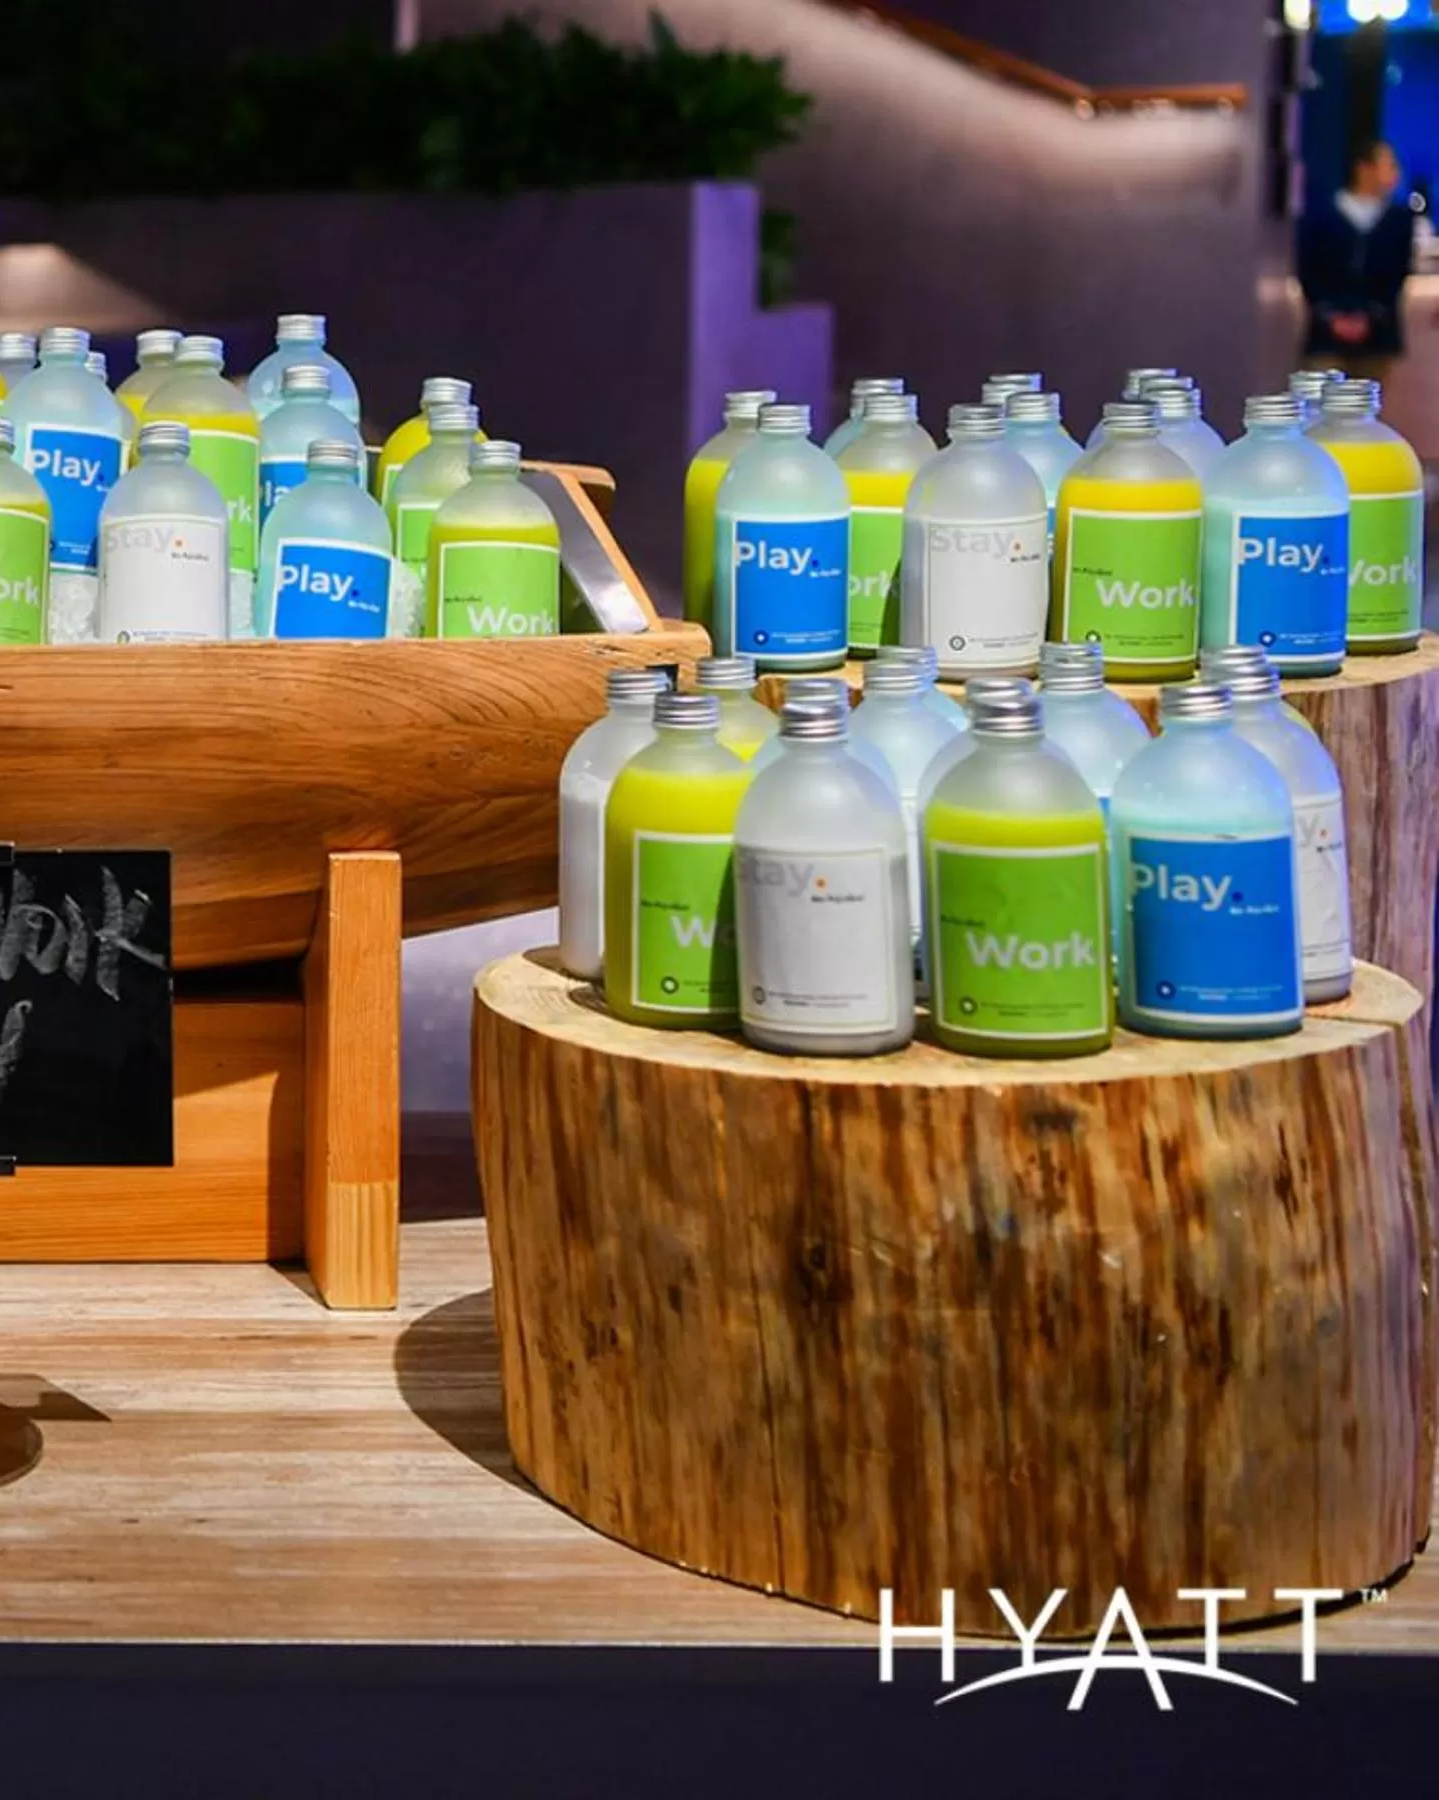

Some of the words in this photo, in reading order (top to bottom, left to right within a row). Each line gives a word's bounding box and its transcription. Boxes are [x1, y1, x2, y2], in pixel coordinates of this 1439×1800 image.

[226, 494, 252, 522] rk
[1095, 577, 1197, 609] Work
[466, 603, 553, 635] Work
[964, 930, 1097, 971] Work
